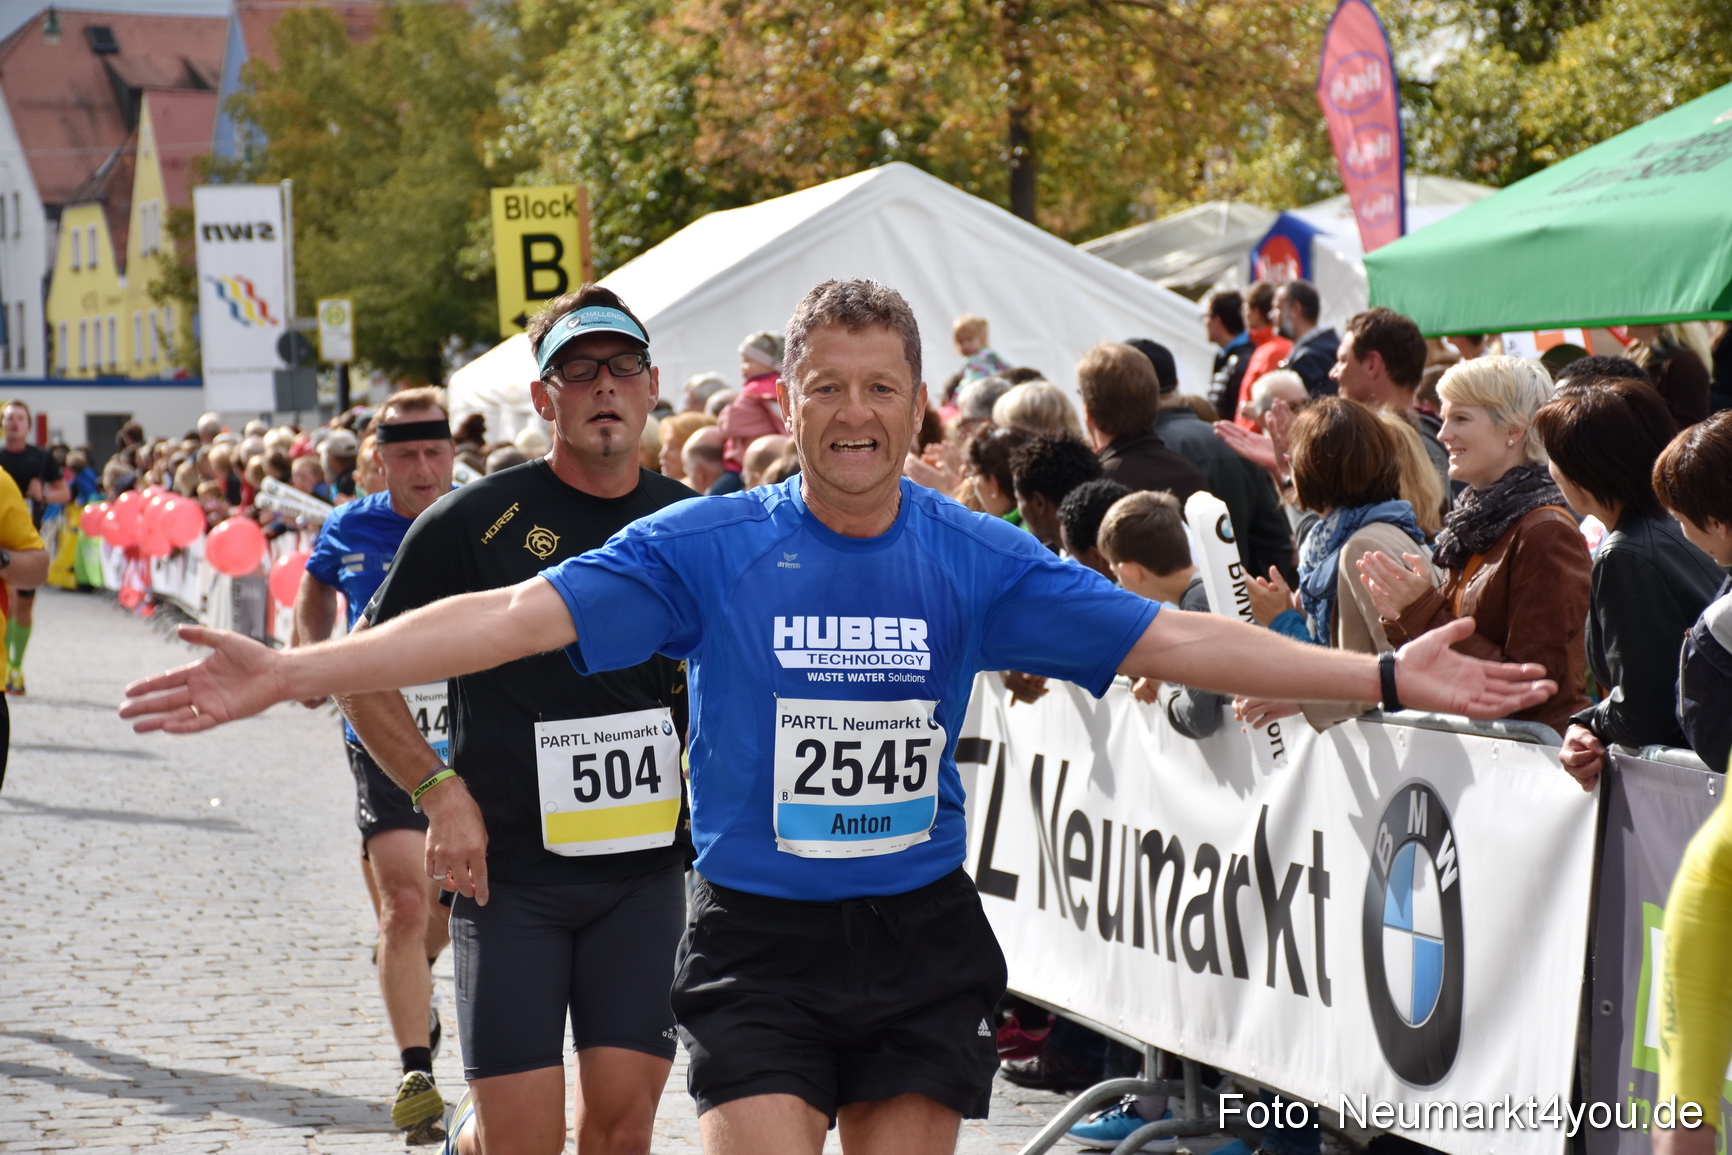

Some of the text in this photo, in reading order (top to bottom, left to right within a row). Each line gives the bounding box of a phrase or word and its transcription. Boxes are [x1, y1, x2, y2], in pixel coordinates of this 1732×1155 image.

[504, 192, 579, 220] Block
[521, 233, 569, 301] B
[581, 311, 627, 322] CHALLENGE
[480, 502, 519, 544] HORST
[773, 616, 930, 650] HUBER
[806, 653, 925, 666] TECHNOLOGY
[807, 672, 926, 683] WASTE WATER Solutions
[415, 692, 449, 703] Neuma
[781, 714, 921, 731] PARTL Neumarkt
[540, 725, 658, 749] PARTL Neumarkt
[572, 745, 661, 803] 504
[794, 738, 931, 797] 2545
[782, 792, 789, 801] B
[831, 813, 891, 835] Anton
[1375, 790, 1458, 893] BMW
[1030, 754, 1332, 1008] Neumarkt
